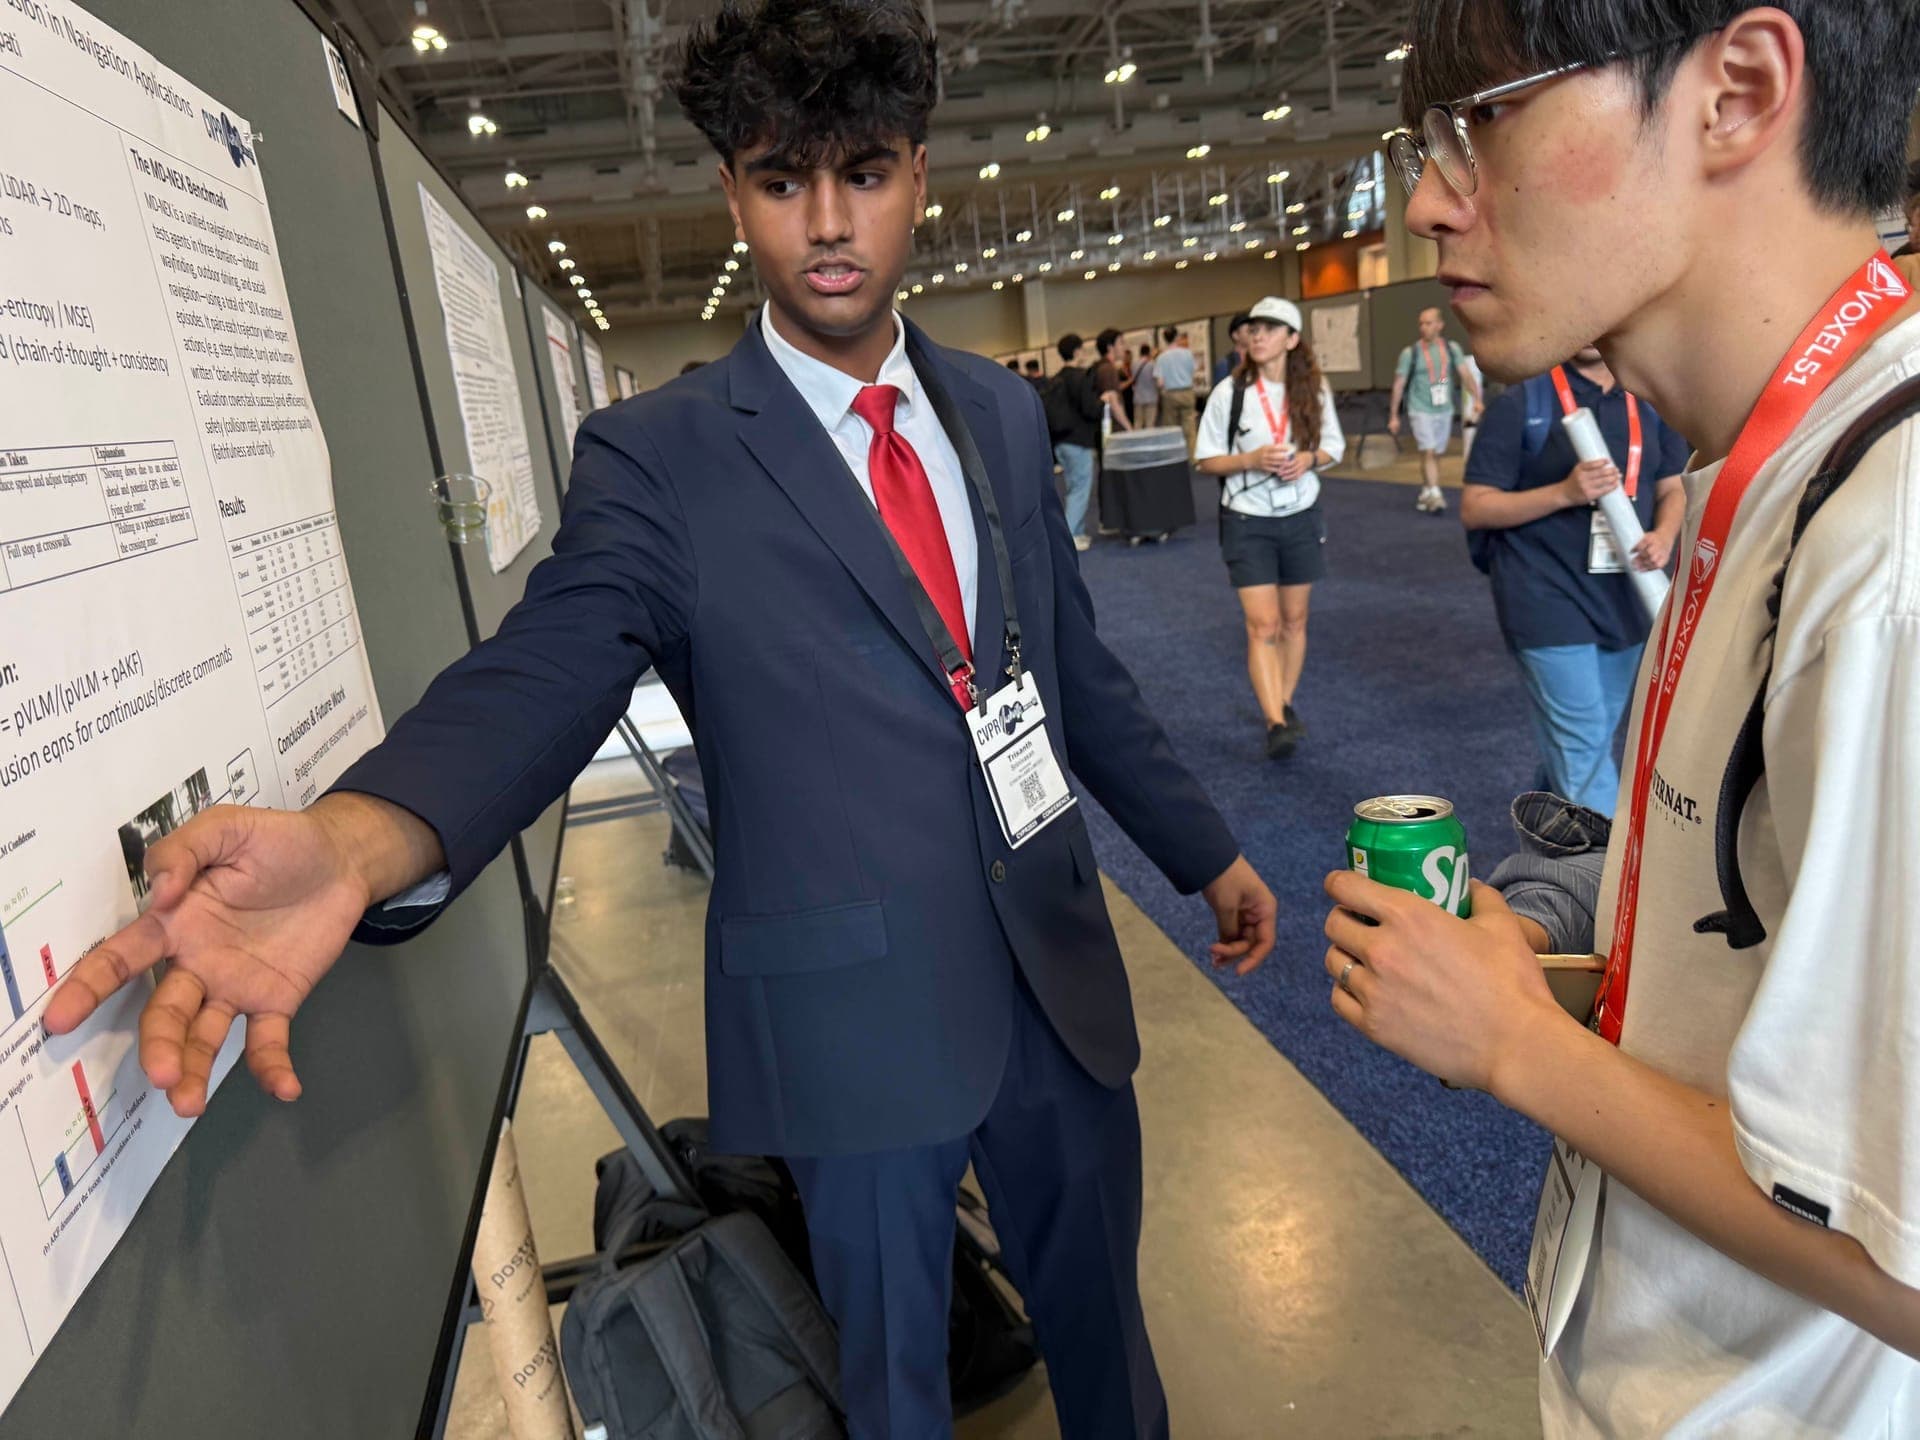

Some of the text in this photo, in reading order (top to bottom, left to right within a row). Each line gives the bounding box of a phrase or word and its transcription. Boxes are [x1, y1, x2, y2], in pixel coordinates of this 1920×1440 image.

[44, 3, 194, 118] in Navigation Applications
[130, 148, 228, 210] The MD-NEX Benchmark
[1, 173, 106, 232] LiDAR 2D maps,
[64, 303, 95, 334] MSE)
[1783, 290, 1882, 386] VOXEL51
[9, 333, 111, 371] (chain-of-thought
[119, 351, 169, 376] consistency
[197, 390, 228, 406] Evaluation
[7, 452, 28, 466] Taken
[218, 496, 246, 518] Results
[1664, 588, 1703, 695] VOXEL51
[112, 649, 144, 690] pAKF)
[43, 731, 75, 763] eqns
[76, 720, 94, 746] for
[96, 667, 192, 735] continuous/discrete
[192, 644, 233, 682] commands
[278, 685, 346, 755] Conclusions & Future Work
[976, 721, 1001, 746] CVPR
[301, 778, 317, 806] control
[8, 828, 36, 852] Confidence
[28, 1037, 41, 1058] High
[8, 1076, 26, 1099] Weight
[50, 1229, 61, 1248] AKF
